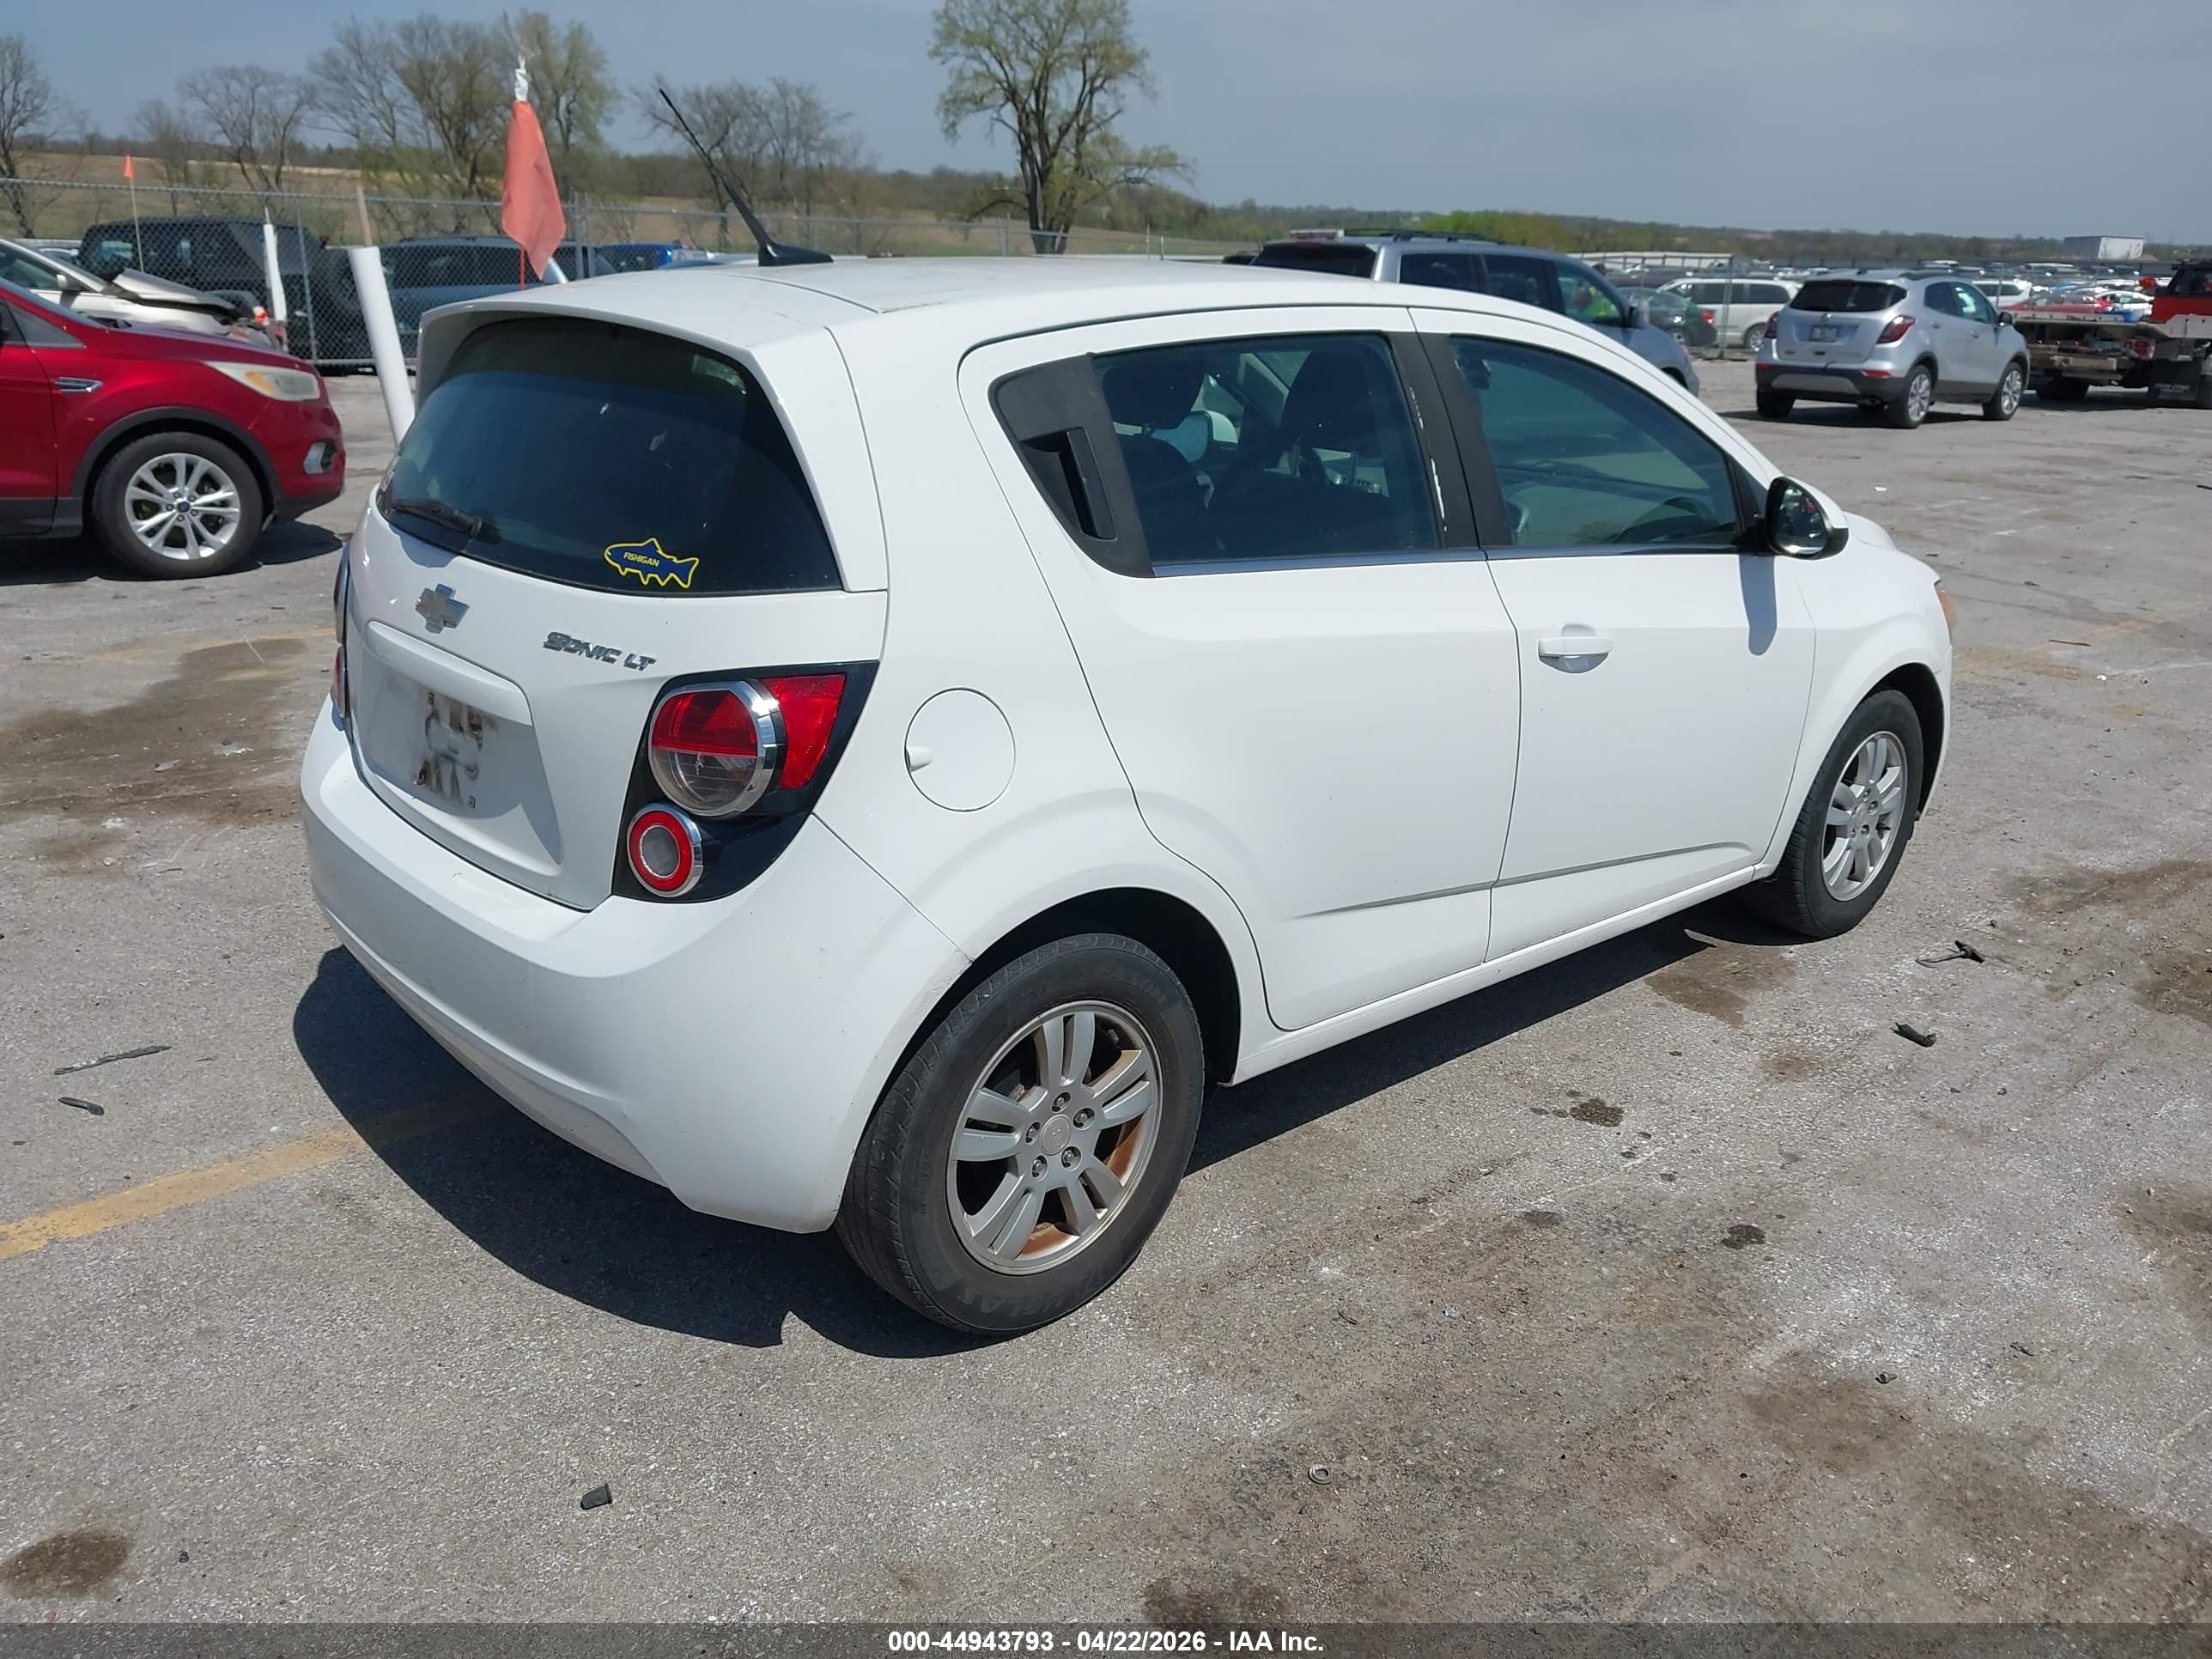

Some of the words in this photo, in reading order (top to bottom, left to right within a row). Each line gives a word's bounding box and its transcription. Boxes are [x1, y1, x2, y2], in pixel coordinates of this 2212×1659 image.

[623, 551, 659, 567] FISHIGAN
[543, 631, 623, 664] SONIC
[623, 653, 657, 671] LT
